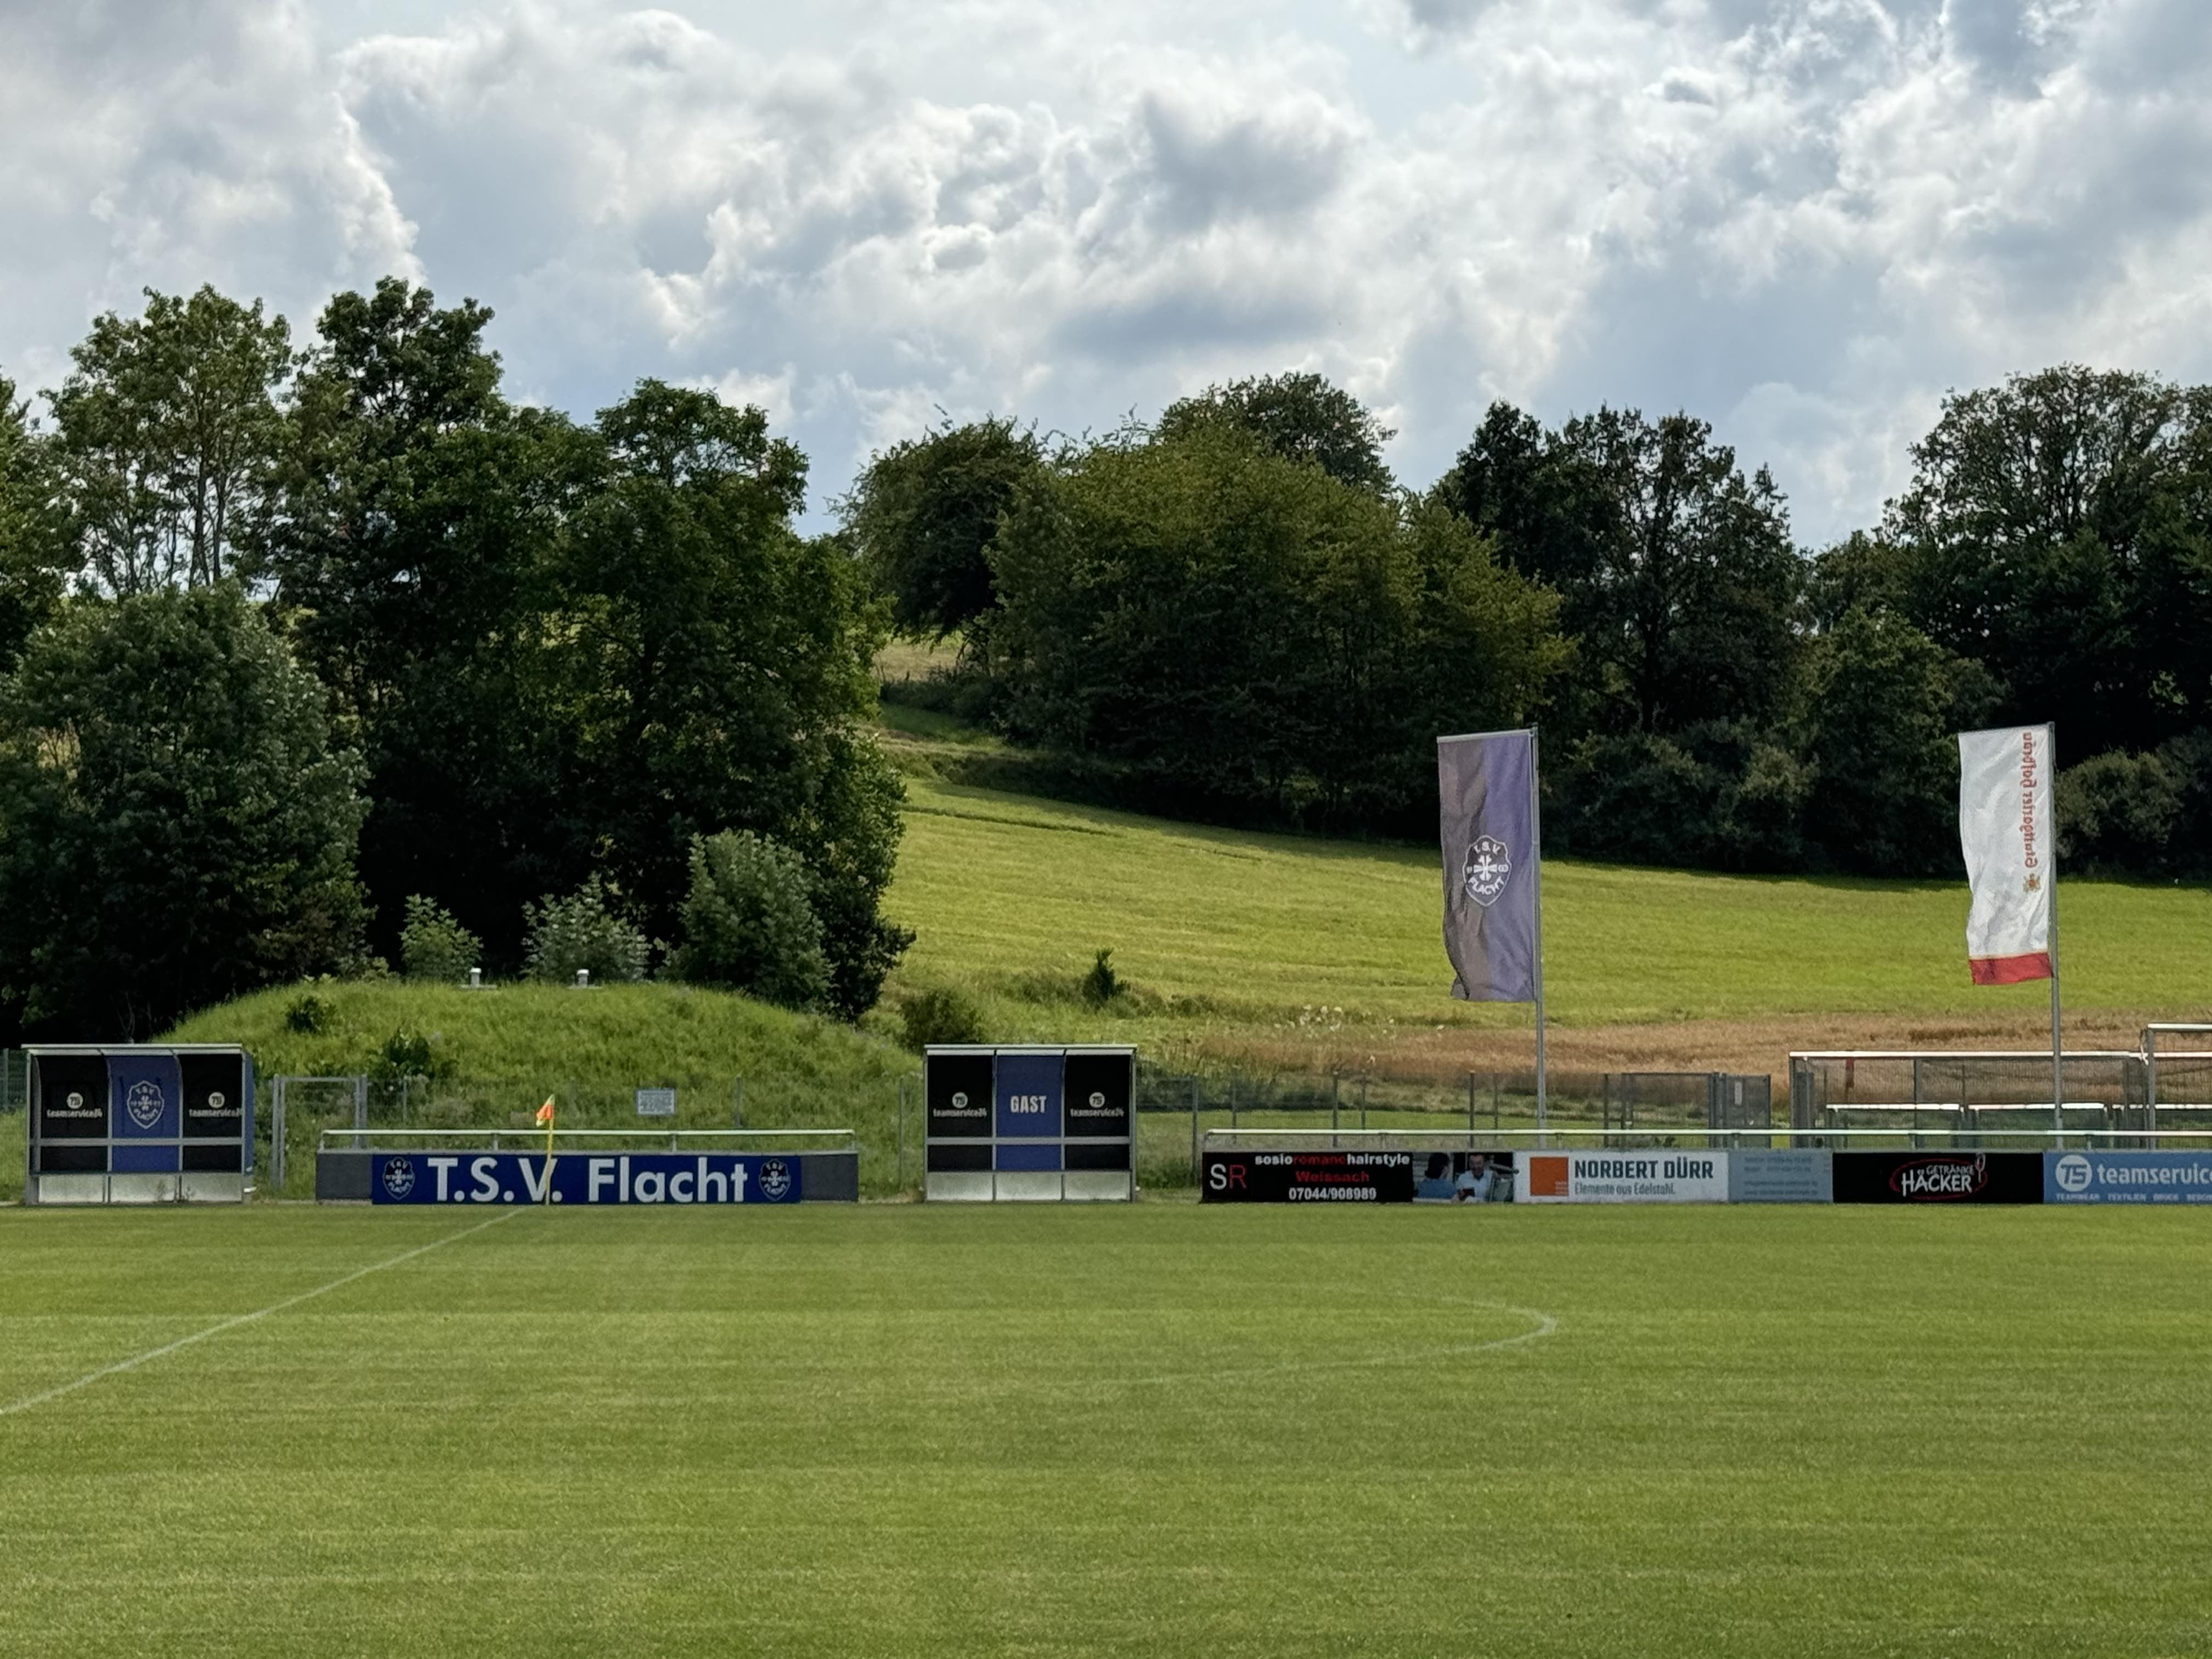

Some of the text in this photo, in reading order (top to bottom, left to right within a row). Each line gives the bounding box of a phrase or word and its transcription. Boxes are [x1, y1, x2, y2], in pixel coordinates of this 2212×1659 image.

[1468, 876, 1504, 895] FLACHT
[1010, 1096, 1047, 1113] GAST
[1296, 1171, 1369, 1182] Weissach
[1575, 1156, 1713, 1178] NORBERT DÜRR
[1926, 1164, 1974, 1175] GETRÄNKE
[2097, 1163, 2212, 1184] teamservic
[427, 1156, 748, 1203] T.S.V. Flacht
[1575, 1181, 1615, 1195] Elemente
[1616, 1184, 1632, 1195] aus
[1901, 1169, 1972, 1197] HÄCKER
